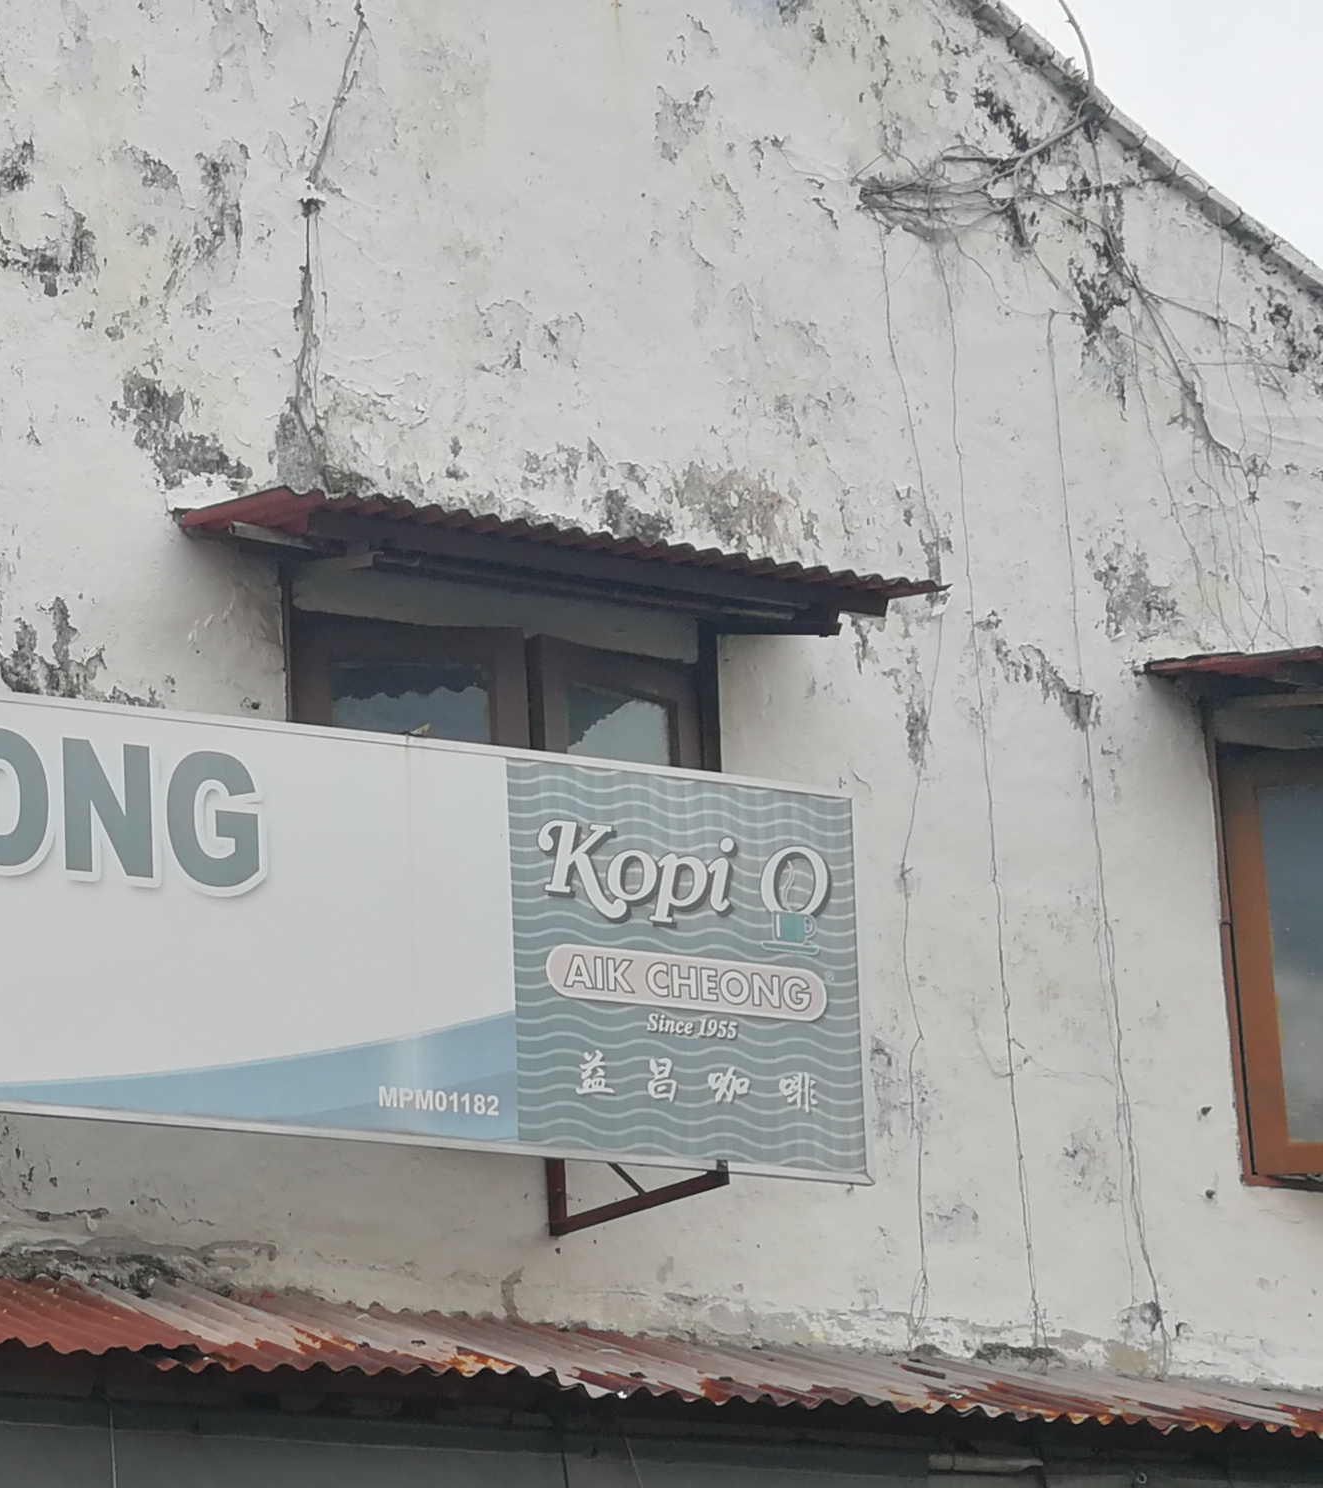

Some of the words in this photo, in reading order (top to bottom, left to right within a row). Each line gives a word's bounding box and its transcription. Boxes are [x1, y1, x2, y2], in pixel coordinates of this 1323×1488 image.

[538, 820, 737, 924] Kopi
[761, 846, 829, 916] O
[564, 954, 634, 993] AIK
[645, 962, 812, 1011] CHEONG
[647, 1013, 693, 1035] Since
[698, 1019, 737, 1039] 1955
[378, 1086, 499, 1116] MPM01182
